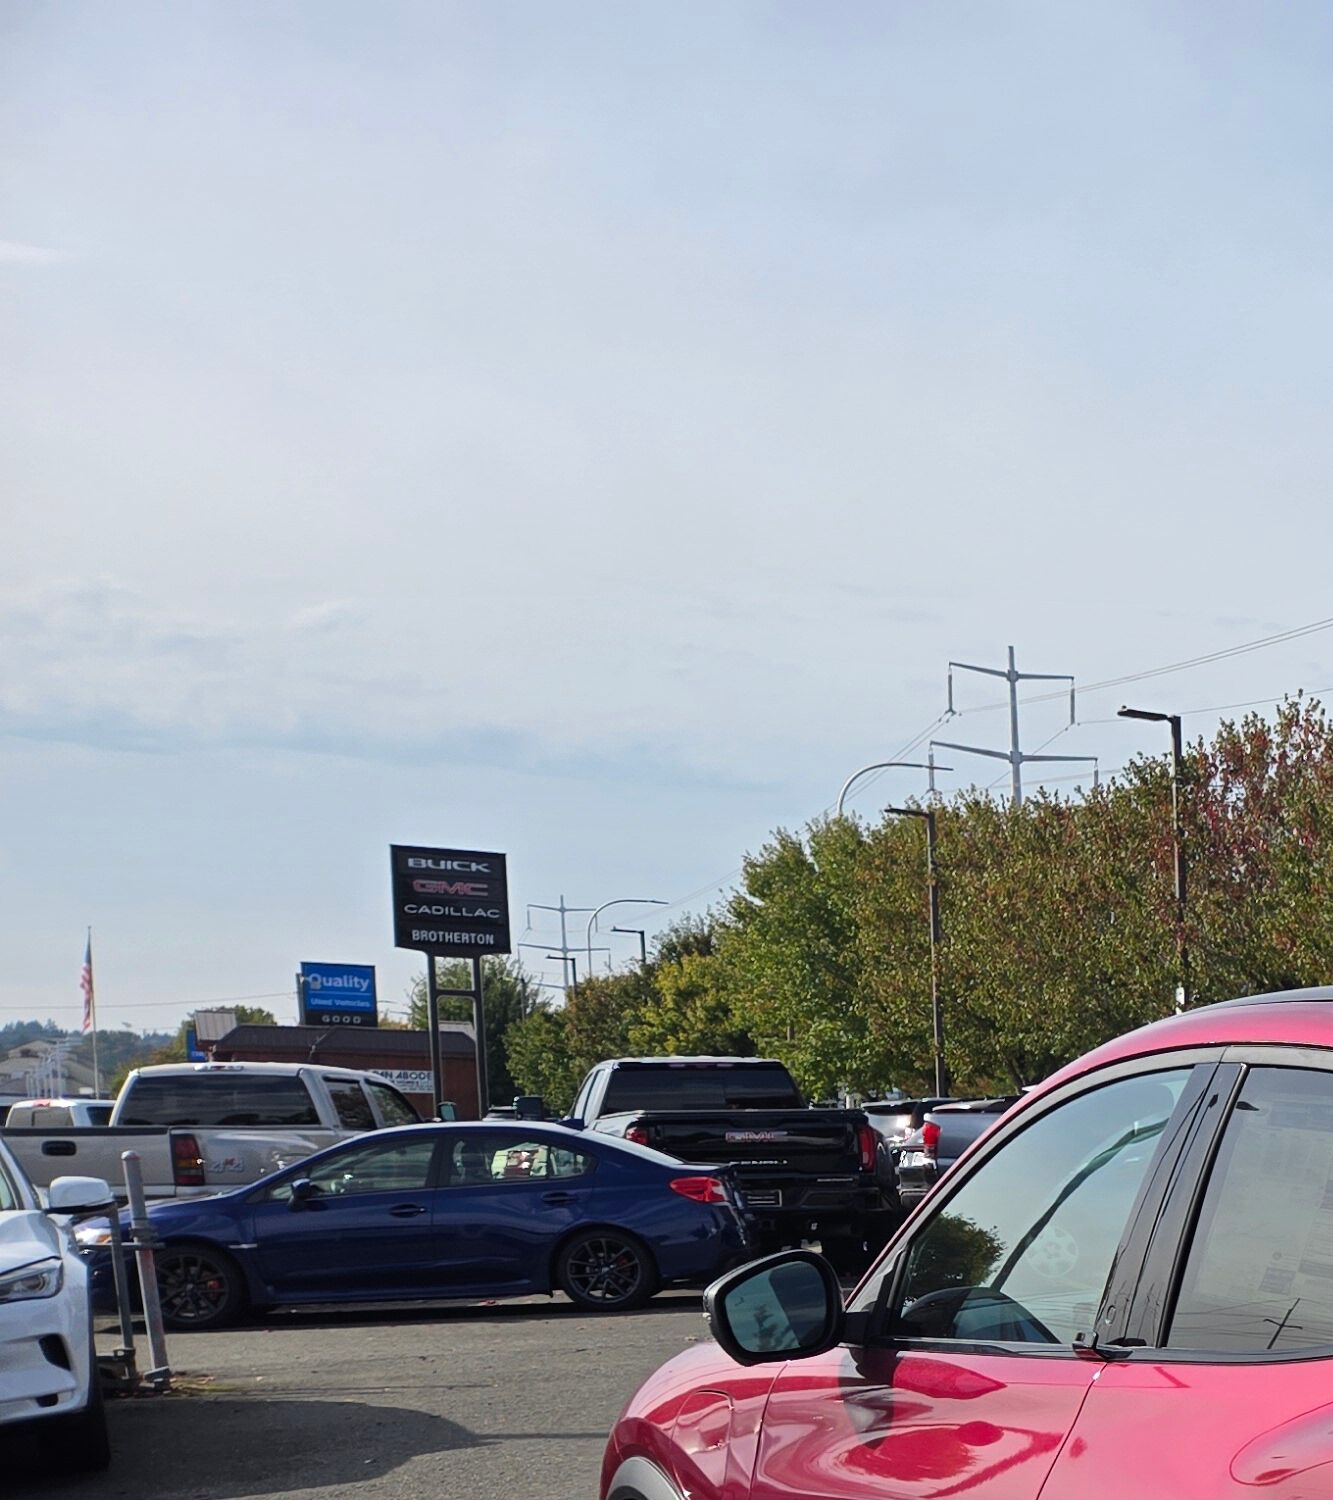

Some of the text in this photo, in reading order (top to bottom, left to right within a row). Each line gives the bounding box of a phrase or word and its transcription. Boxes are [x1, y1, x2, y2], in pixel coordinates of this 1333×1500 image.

[407, 857, 491, 873] BUICK
[412, 879, 489, 896] GMC
[403, 904, 500, 918] CADILLAC
[411, 929, 495, 945] BROTHERTON
